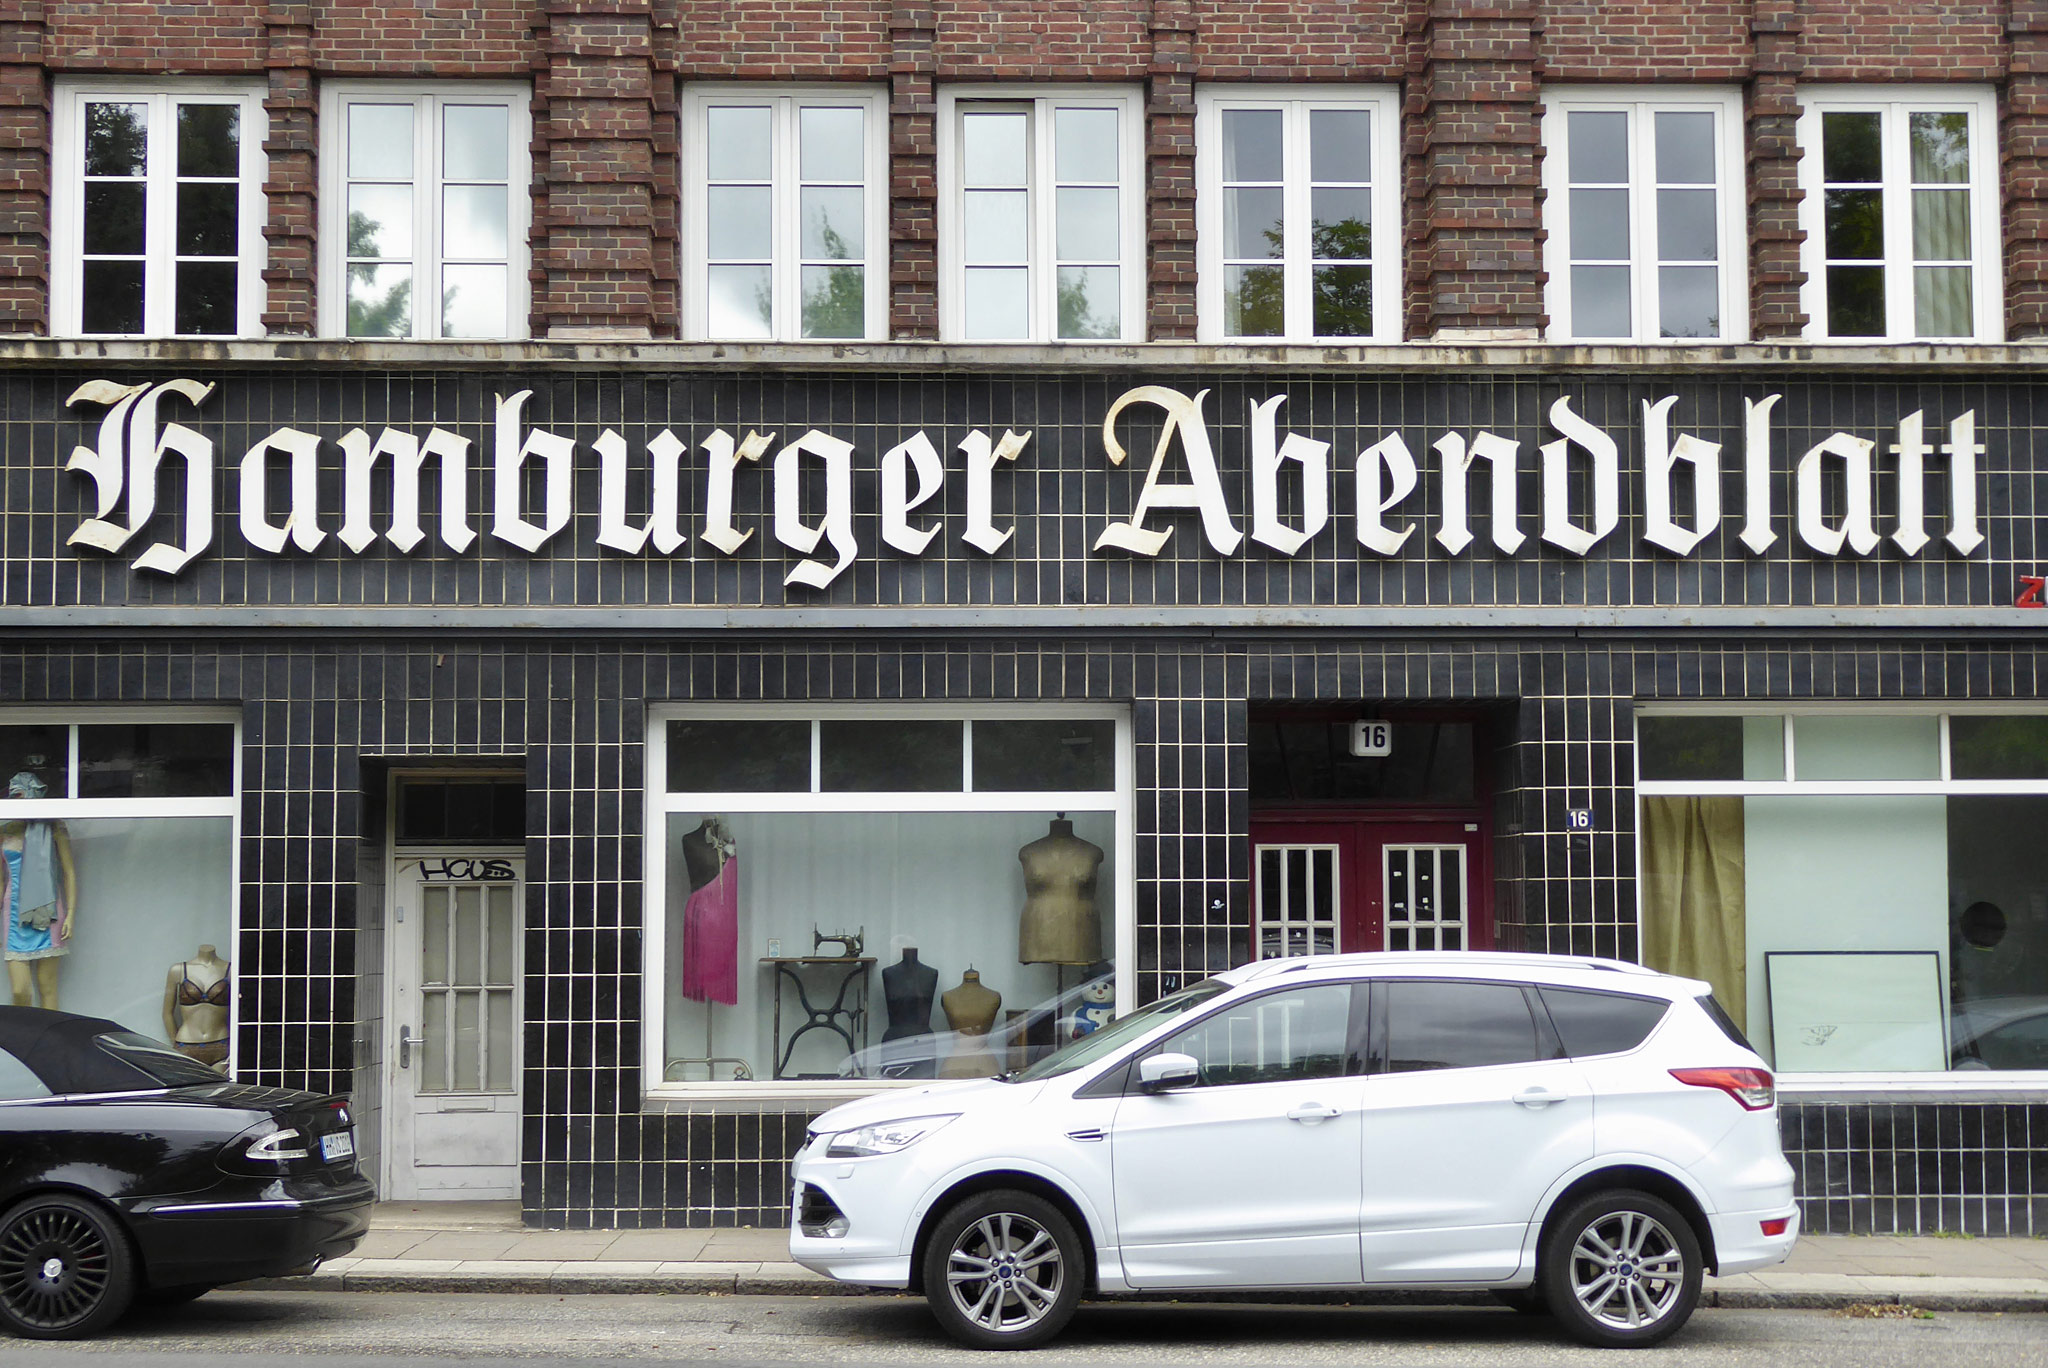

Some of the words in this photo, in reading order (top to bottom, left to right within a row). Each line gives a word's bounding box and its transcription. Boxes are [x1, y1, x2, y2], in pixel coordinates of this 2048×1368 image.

[65, 378, 1033, 590] Hamburger
[1092, 385, 1985, 557] Abendblatt
[1362, 726, 1386, 748] 16
[1570, 810, 1589, 828] 16
